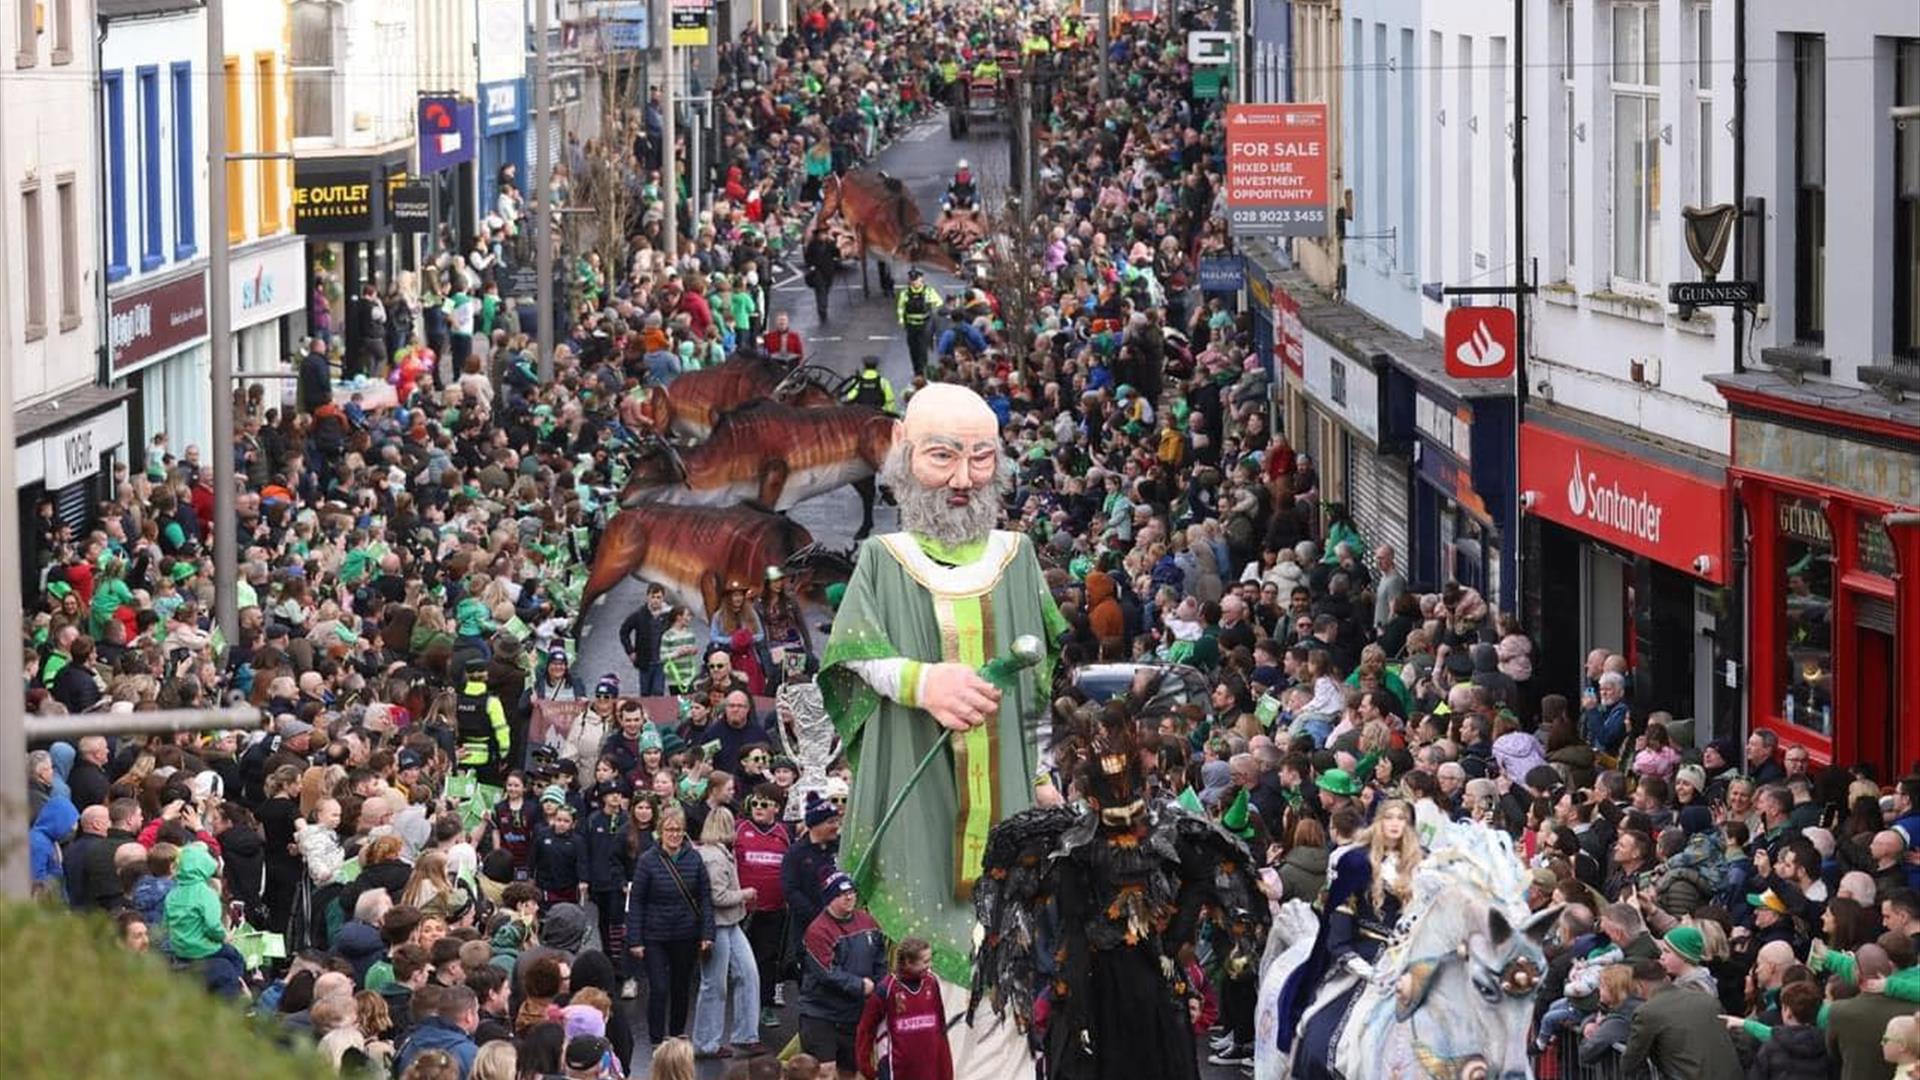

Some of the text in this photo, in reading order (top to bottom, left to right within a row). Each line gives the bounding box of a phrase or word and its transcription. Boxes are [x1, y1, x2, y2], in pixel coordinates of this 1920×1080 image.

[1232, 142, 1320, 157] FOR SALE
[1232, 162, 1293, 173] MIXED USE
[1232, 176, 1304, 186] INVESTMENT
[310, 185, 369, 203] OUTLET
[1232, 189, 1313, 200] OPPORTUNITY
[1233, 210, 1324, 222] 028 9023 3455
[1679, 285, 1748, 301] GUINNESS
[64, 430, 93, 479] VOGUE
[1587, 472, 1662, 543] Santander
